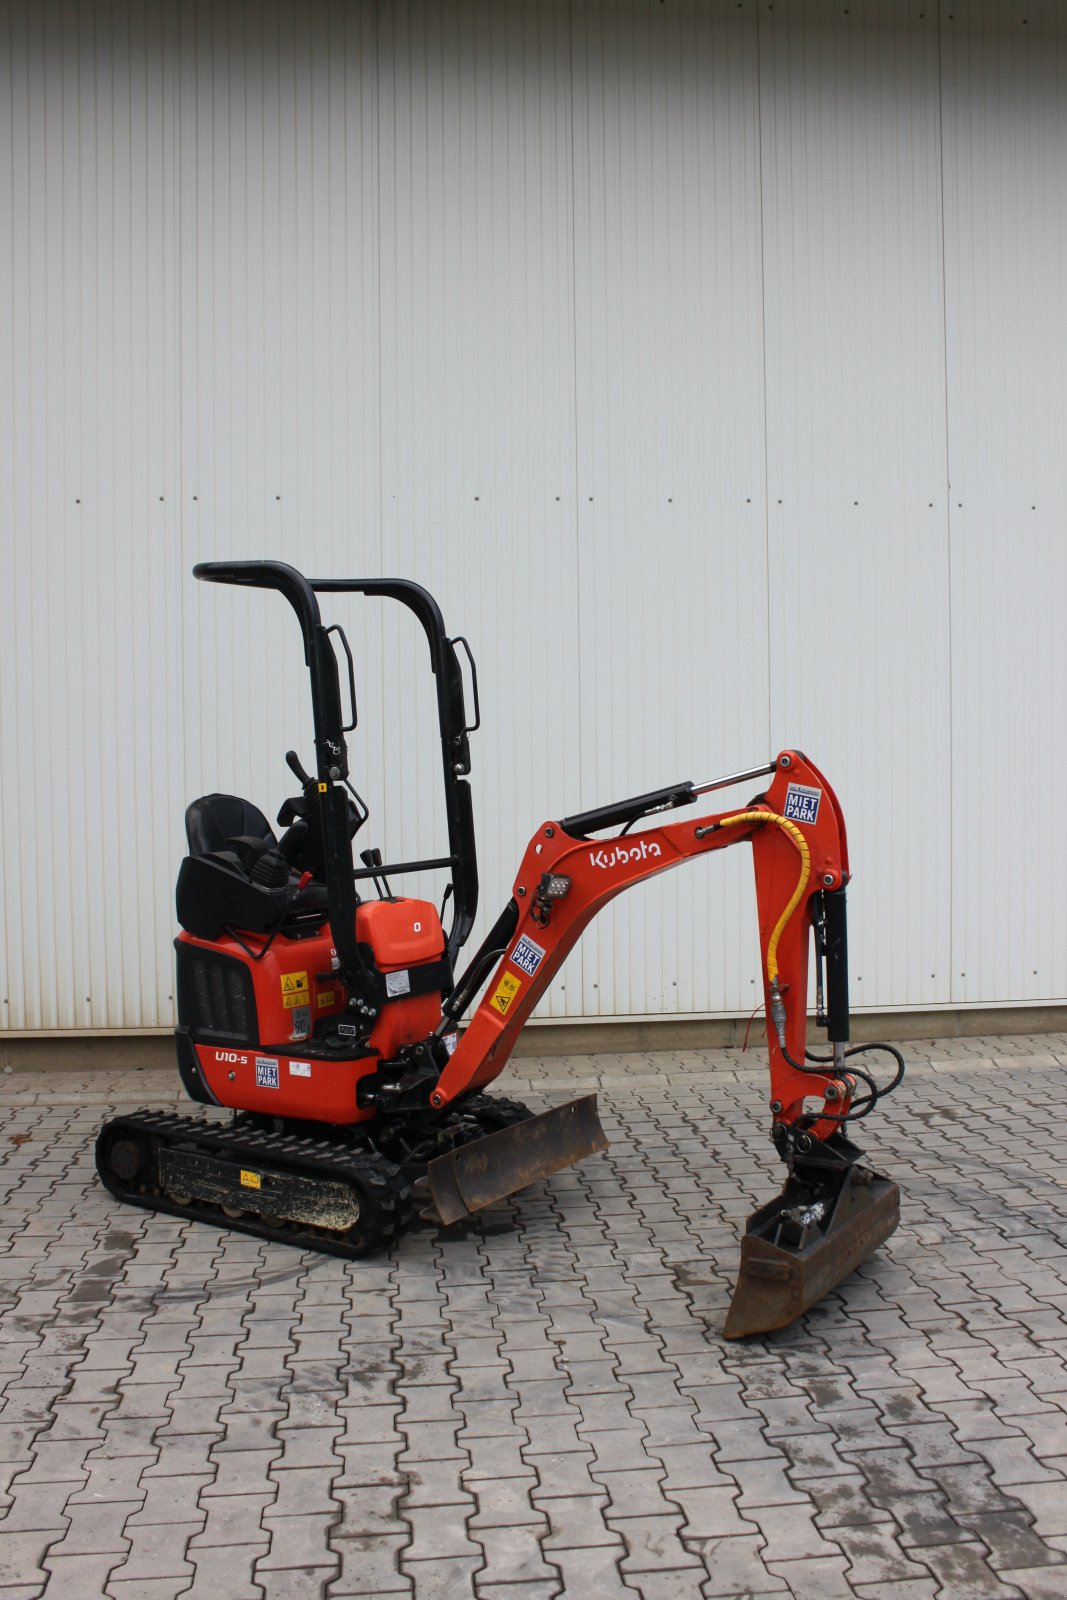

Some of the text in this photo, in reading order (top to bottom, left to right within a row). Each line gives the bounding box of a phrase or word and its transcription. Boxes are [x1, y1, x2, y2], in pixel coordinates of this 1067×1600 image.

[788, 793, 817, 810] MIET
[786, 805, 815, 822] PARK
[589, 841, 661, 868] Kubota
[512, 951, 535, 974] PARK
[517, 943, 540, 965] MIET
[257, 1066, 277, 1077] MIET
[257, 1076, 278, 1086] PARK
